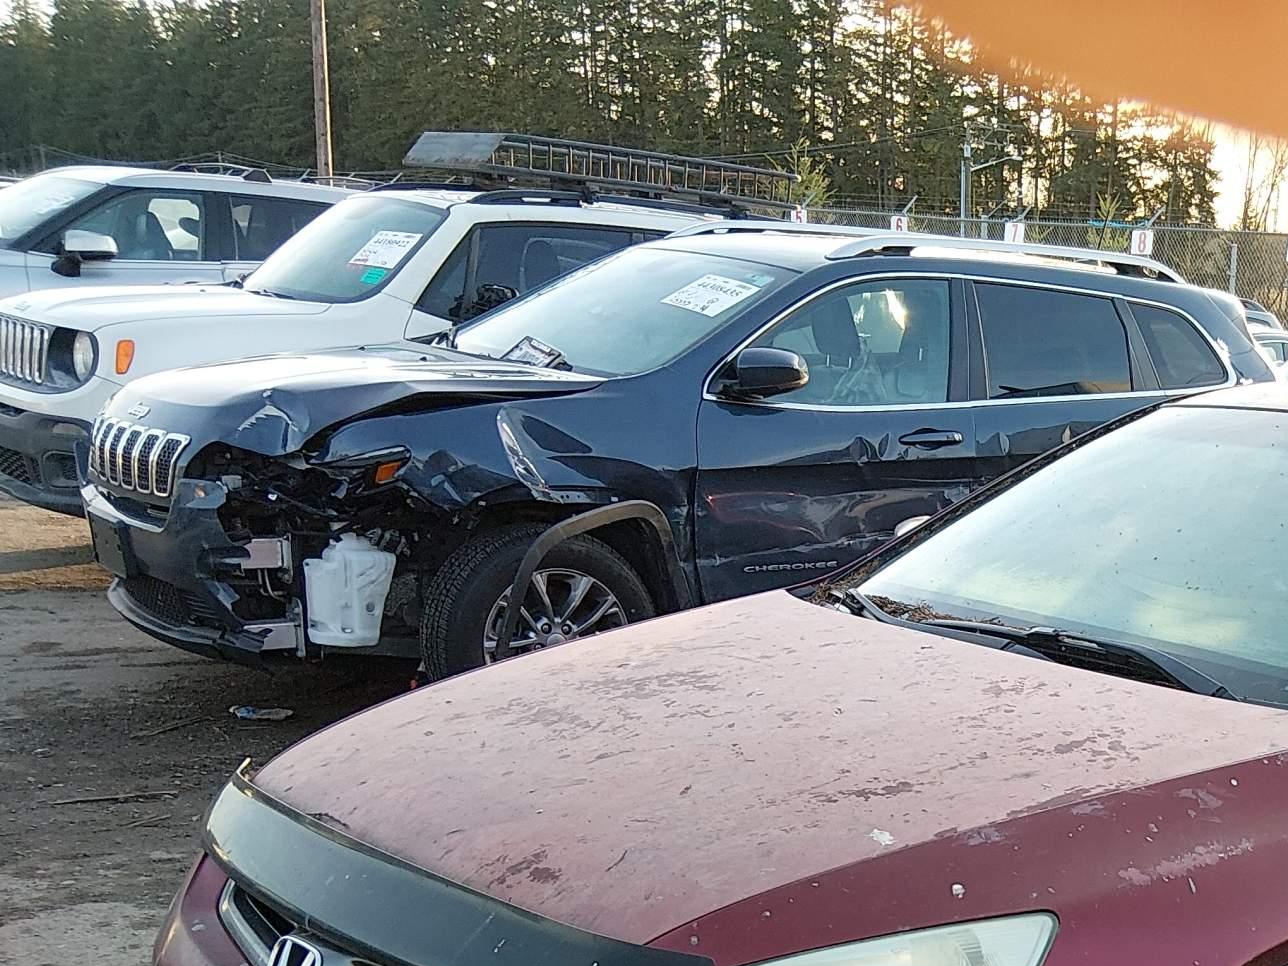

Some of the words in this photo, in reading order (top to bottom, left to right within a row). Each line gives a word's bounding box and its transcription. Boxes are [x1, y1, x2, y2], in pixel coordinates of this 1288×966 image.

[895, 217, 903, 231] 6
[1011, 223, 1020, 242] 7
[1138, 231, 1148, 253] 8
[743, 560, 838, 573] CHEROKEE
